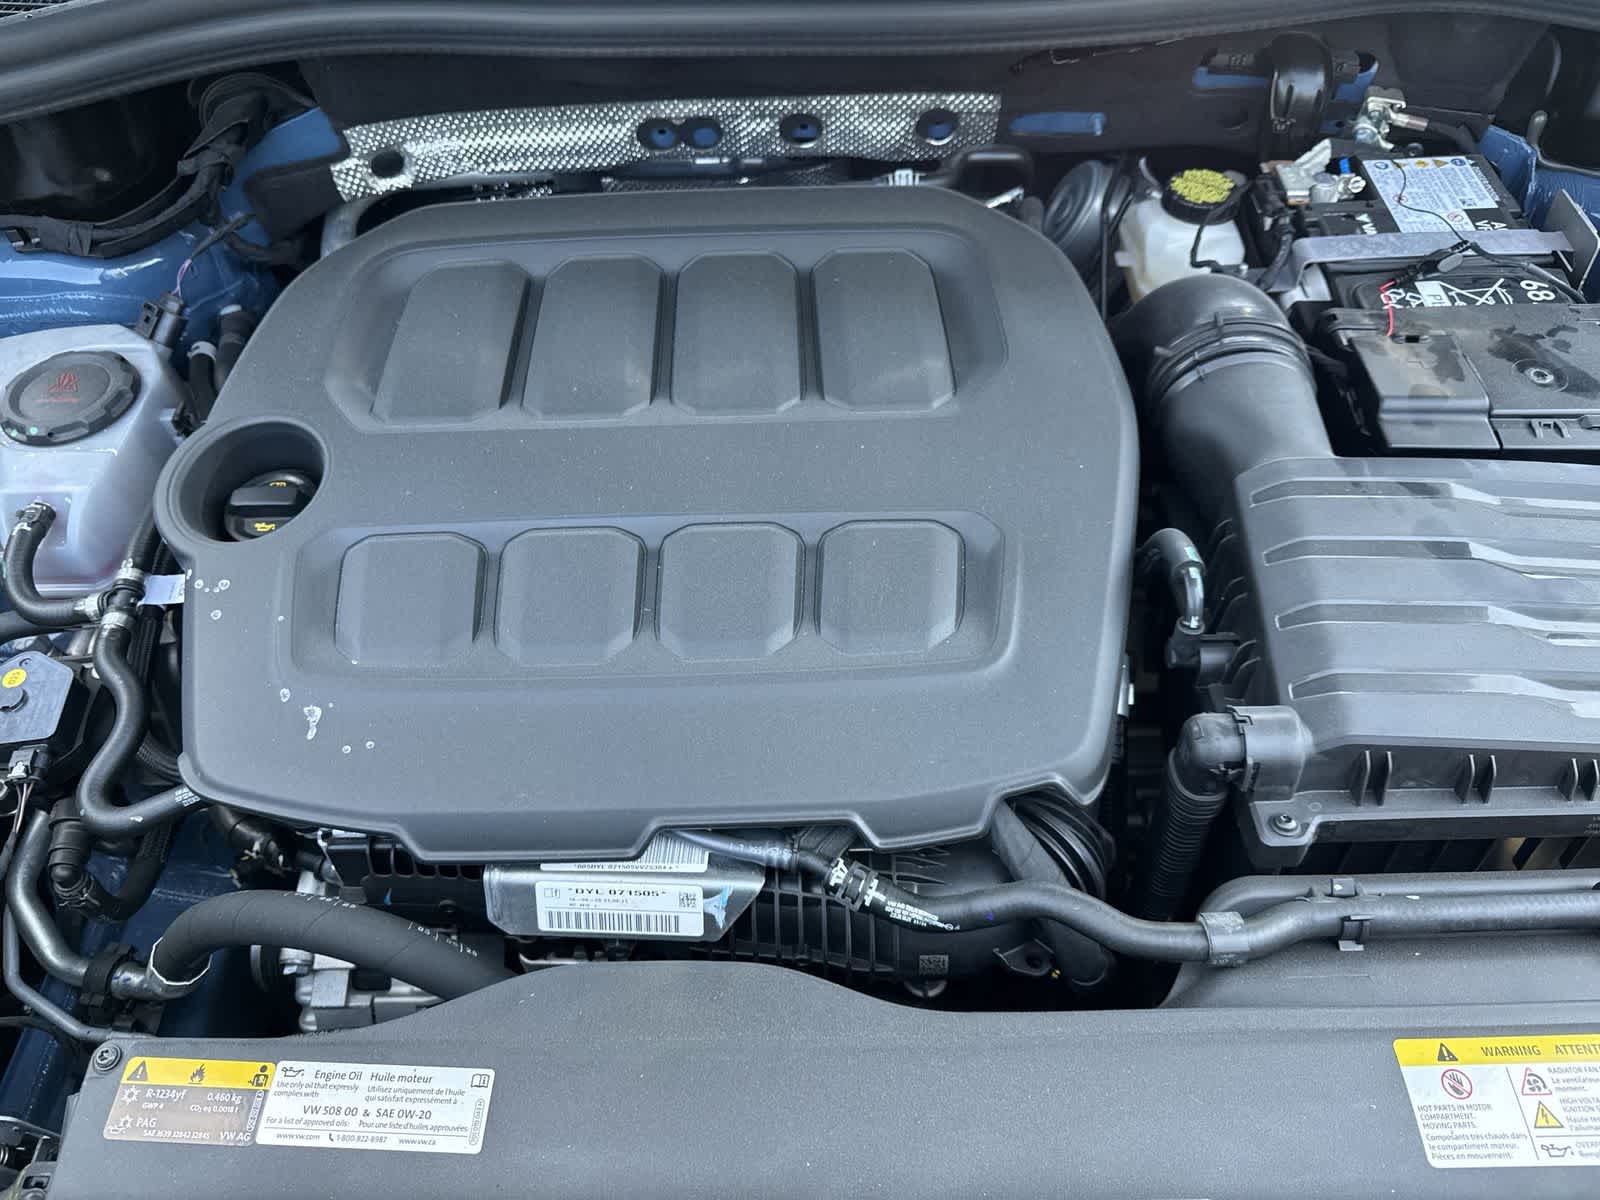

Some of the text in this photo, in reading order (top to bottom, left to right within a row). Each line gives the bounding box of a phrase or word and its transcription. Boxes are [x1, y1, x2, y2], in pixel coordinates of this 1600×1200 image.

[1480, 1045, 1542, 1057] WARNING
[314, 1070, 362, 1082] Engine Oil
[370, 1072, 433, 1084] Huile moteur
[289, 1081, 304, 1091] only
[328, 1084, 359, 1092] expressly
[367, 1085, 392, 1094] Utilisez
[393, 1087, 434, 1096] uniquement
[145, 1088, 187, 1102] R-1234yf
[231, 1093, 242, 1105] kg
[273, 1090, 303, 1099] complies
[364, 1095, 376, 1103] qui
[377, 1095, 404, 1103] satisfait
[303, 1105, 432, 1120] VW 508 00 & SAE 0W-20
[1417, 1103, 1493, 1113] HOT PARTS IN MOTOR
[136, 1117, 157, 1128] PAG
[266, 1116, 277, 1124] For
[284, 1116, 294, 1125] list
[295, 1117, 304, 1125] of
[303, 1117, 335, 1128] approved
[359, 1119, 375, 1128] Pour
[375, 1121, 388, 1129] une
[1422, 1121, 1452, 1130] MOVING
[220, 1131, 252, 1142] VW AG
